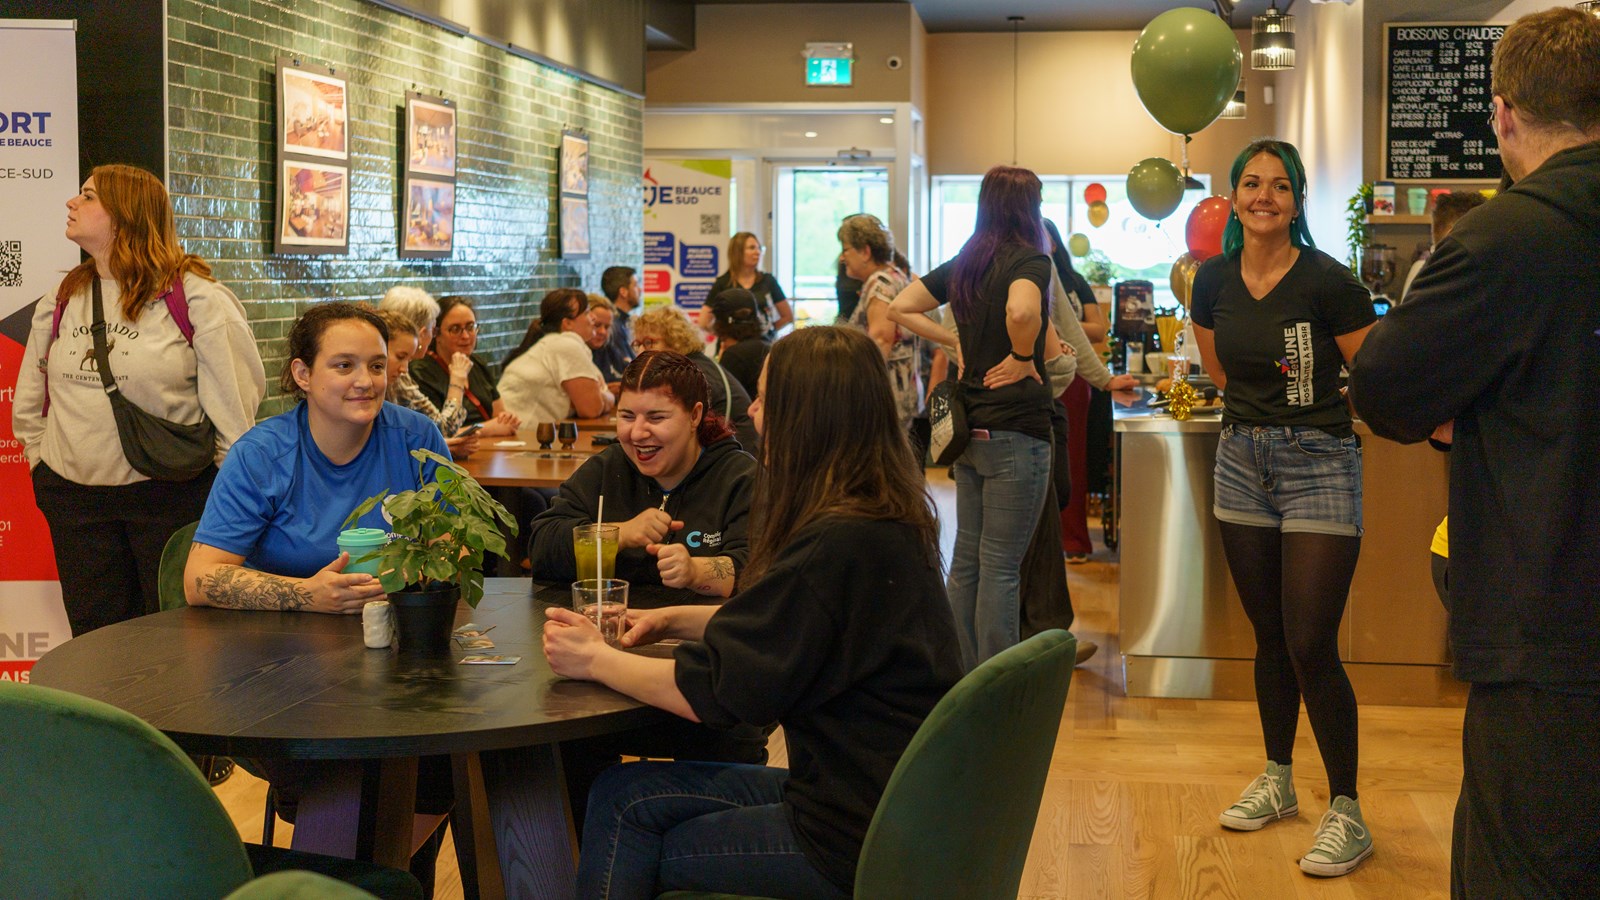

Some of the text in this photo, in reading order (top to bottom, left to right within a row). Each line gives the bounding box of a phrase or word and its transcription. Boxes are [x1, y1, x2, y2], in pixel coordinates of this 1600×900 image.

[1397, 27, 1504, 40] BOISSONS CHAUDES
[676, 187, 722, 195] BEAUCE
[72, 322, 139, 340] CORADO
[1301, 326, 1310, 352] SAISIR
